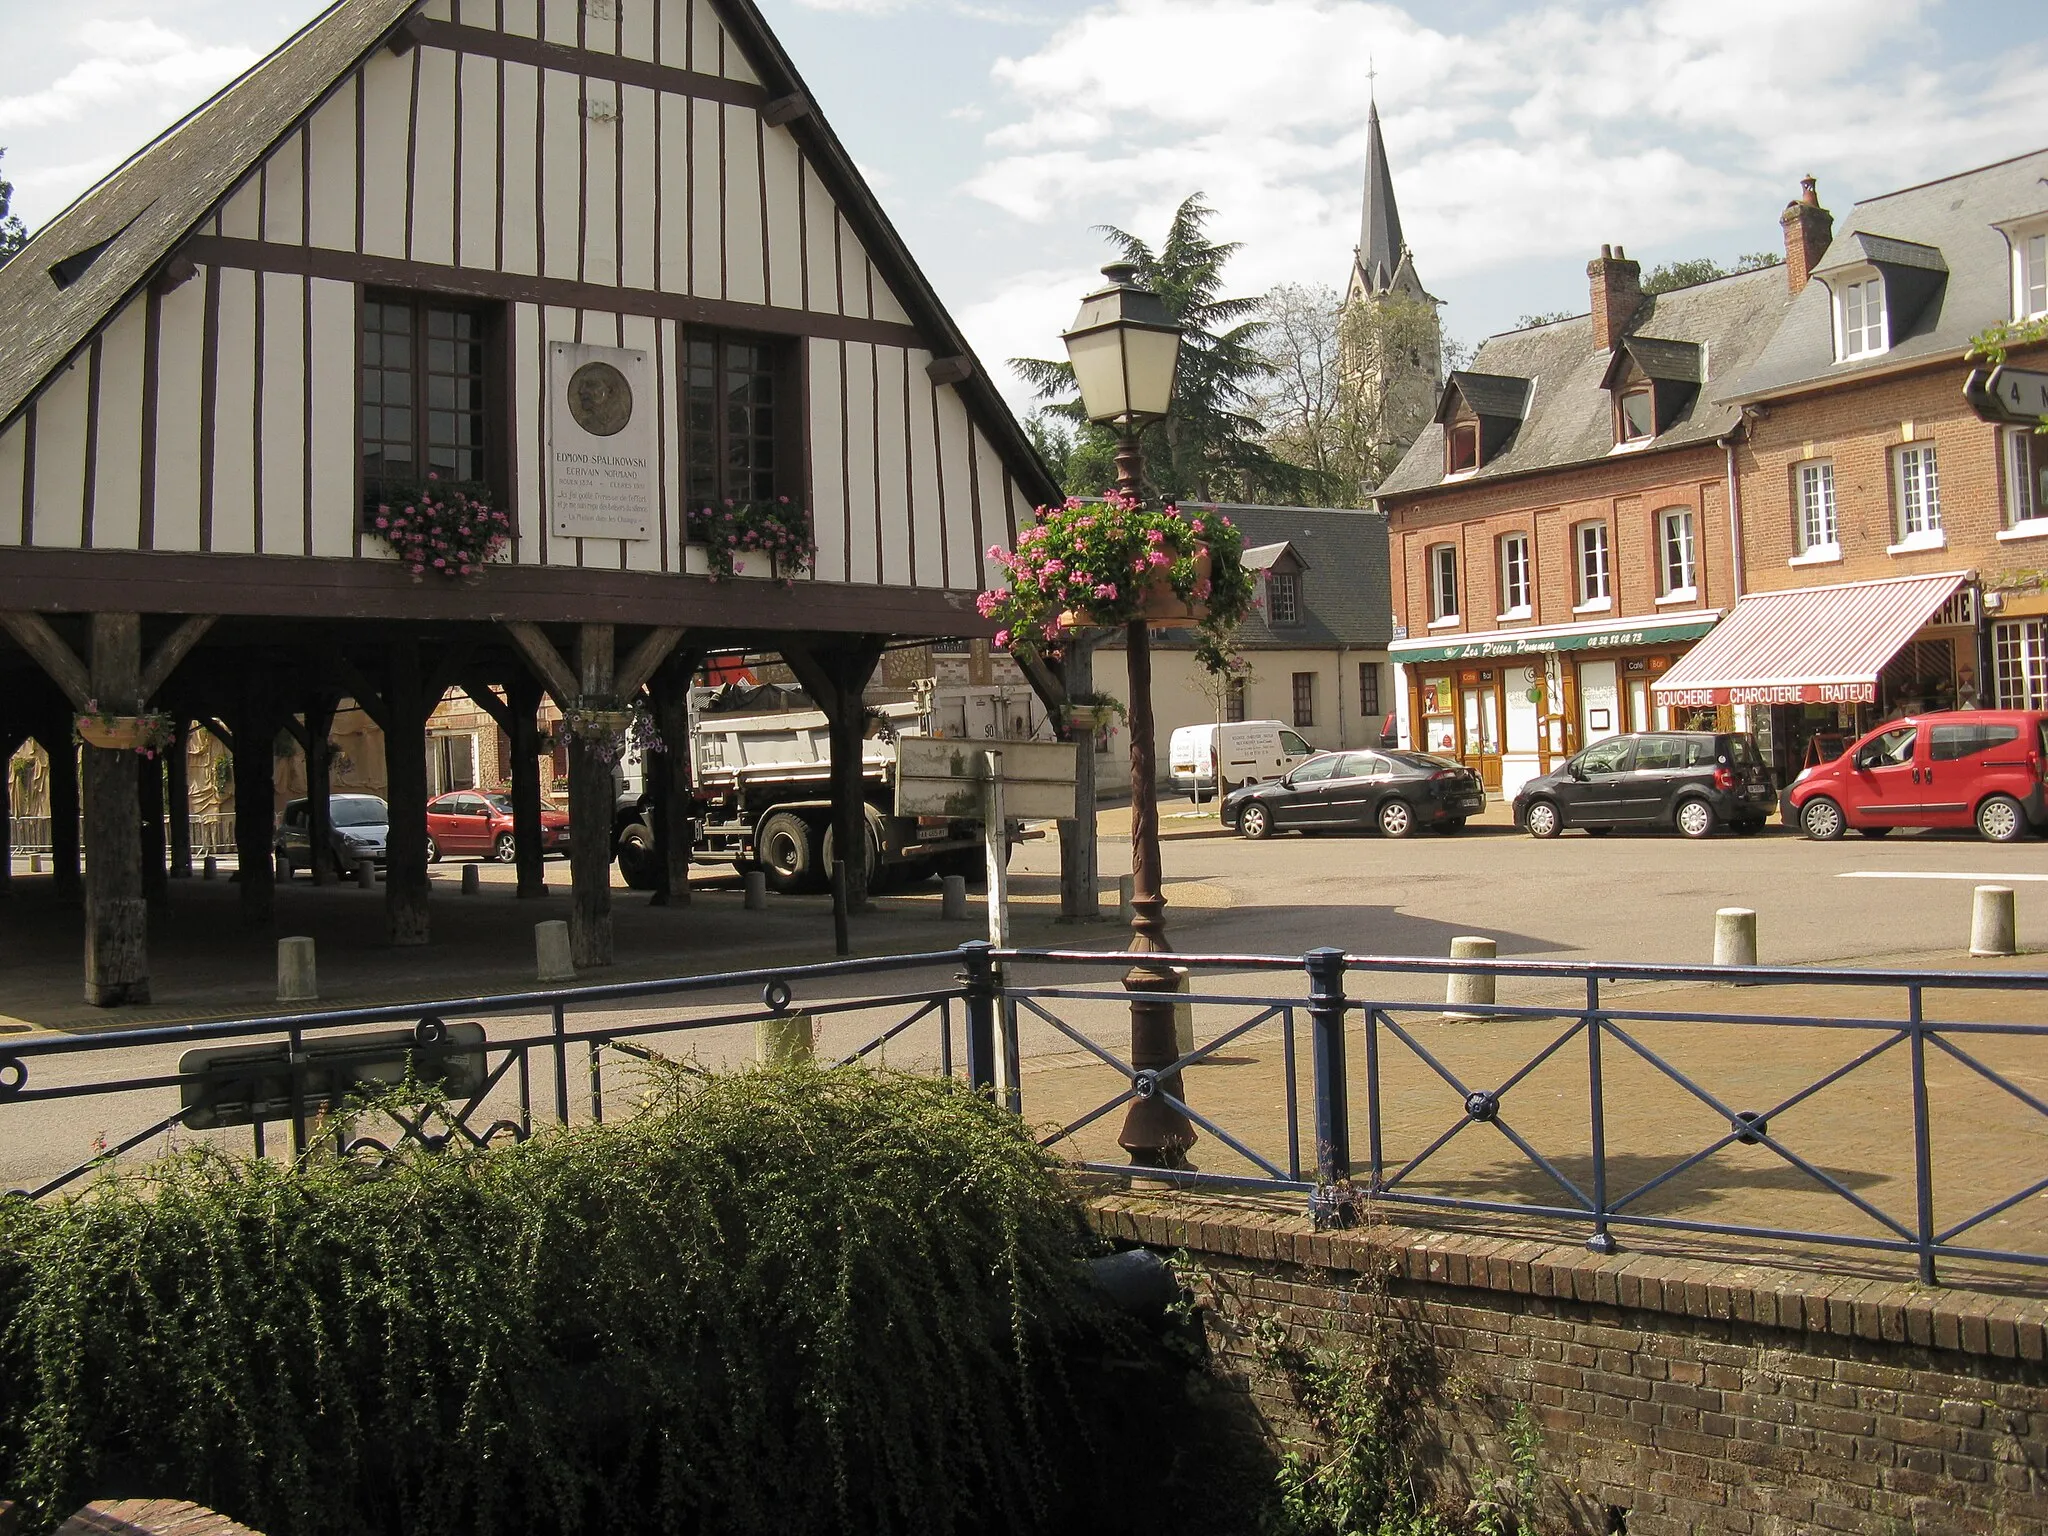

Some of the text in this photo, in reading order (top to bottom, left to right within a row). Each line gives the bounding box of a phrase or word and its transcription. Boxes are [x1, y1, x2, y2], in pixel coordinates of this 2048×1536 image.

[556, 452, 647, 468] EDMOND SPALIKOWSKI
[604, 469, 638, 480] NORMAND
[1587, 637, 1597, 647] 02
[1598, 635, 1609, 645] 32
[1620, 633, 1631, 643] 02
[1632, 632, 1643, 642] 73
[1460, 644, 1479, 658] Les
[1516, 639, 1555, 654] Pommes
[1652, 659, 1664, 668] Bar
[1482, 671, 1492, 680] Bar
[1656, 682, 1873, 706] BOUCHERIE CHARCUTERIE TRAITEUR
[984, 723, 994, 738] 90
